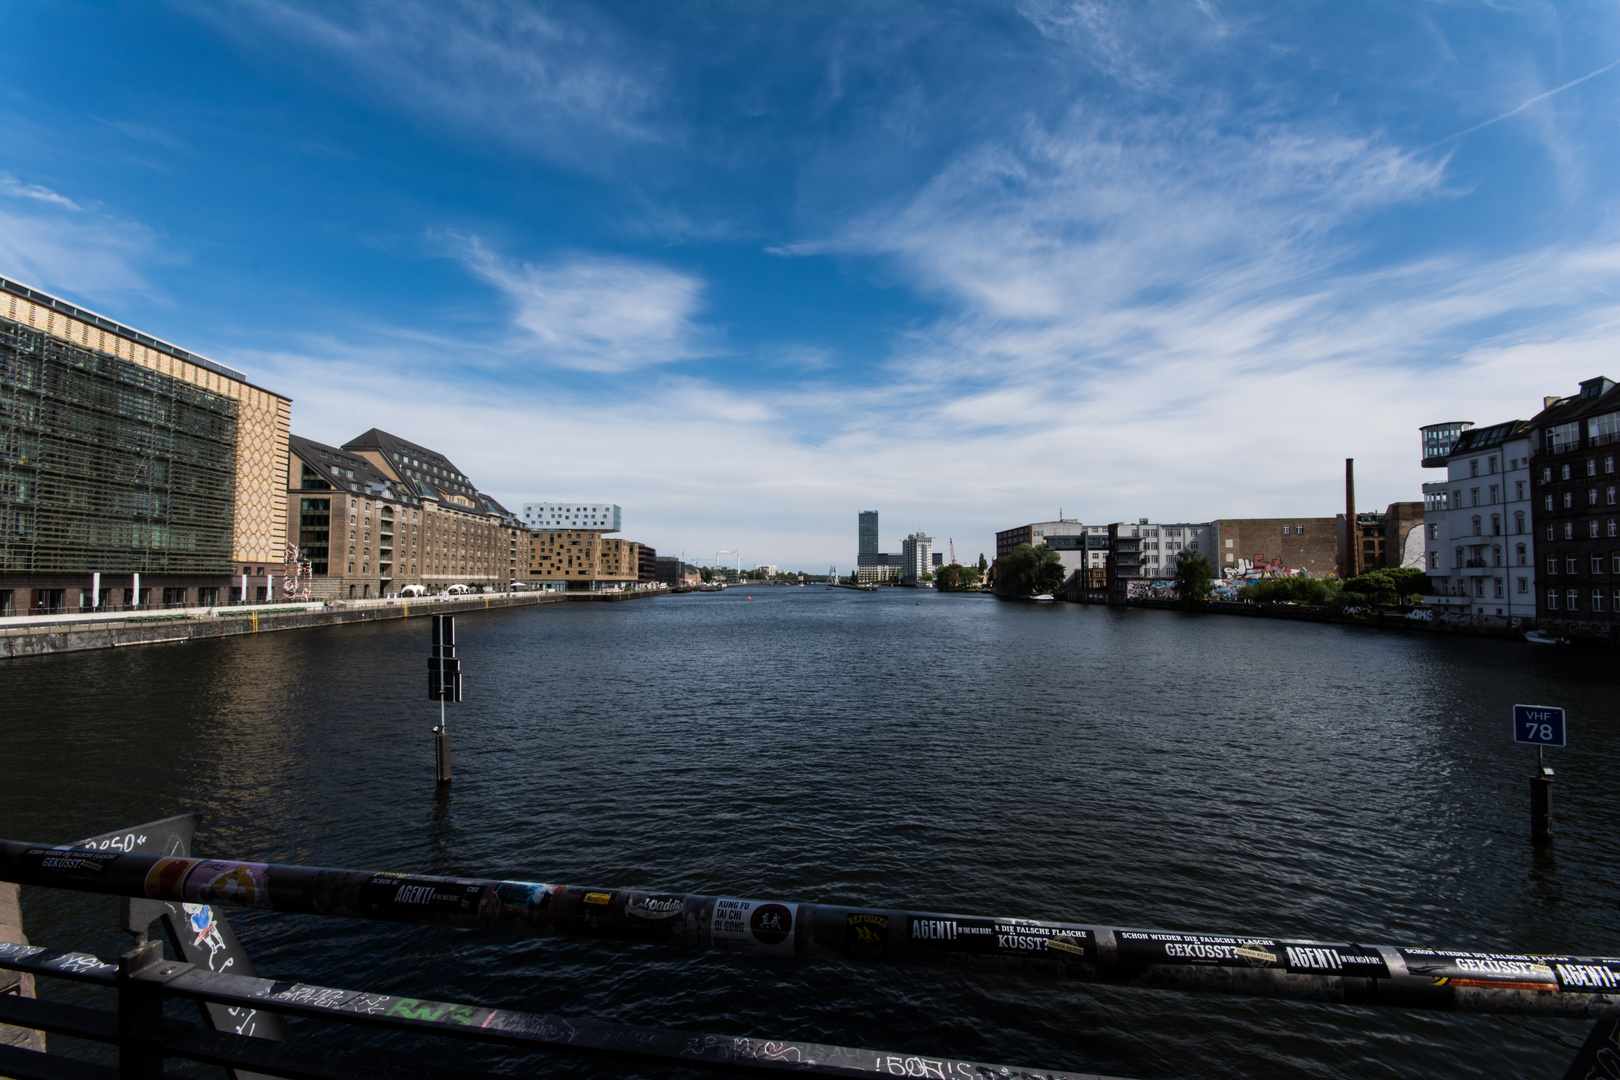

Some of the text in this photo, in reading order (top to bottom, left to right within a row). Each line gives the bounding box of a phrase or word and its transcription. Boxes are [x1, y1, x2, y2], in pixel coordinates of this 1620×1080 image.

[1525, 711, 1552, 721] VHF
[1525, 722, 1554, 741] 78
[394, 884, 436, 905] AGENT!
[718, 901, 751, 910] KUNG FU
[716, 909, 742, 920] TAI CHI
[847, 914, 889, 929] REFUGEES
[714, 920, 745, 933] QI GONG
[911, 919, 958, 940] AGENT!
[1001, 925, 1015, 933] DIE
[1016, 926, 1050, 935] FALSCHE
[1052, 929, 1087, 938] FLASCHE
[997, 932, 1049, 951] KÜSST?
[1121, 932, 1149, 940] SCHON
[1236, 938, 1275, 946] FLASCHE
[1165, 942, 1239, 959] GEKÜSST?
[1285, 946, 1343, 970] AGENT!
[1455, 957, 1537, 976] GEKÜSST?
[1555, 964, 1618, 988] AGENT!
